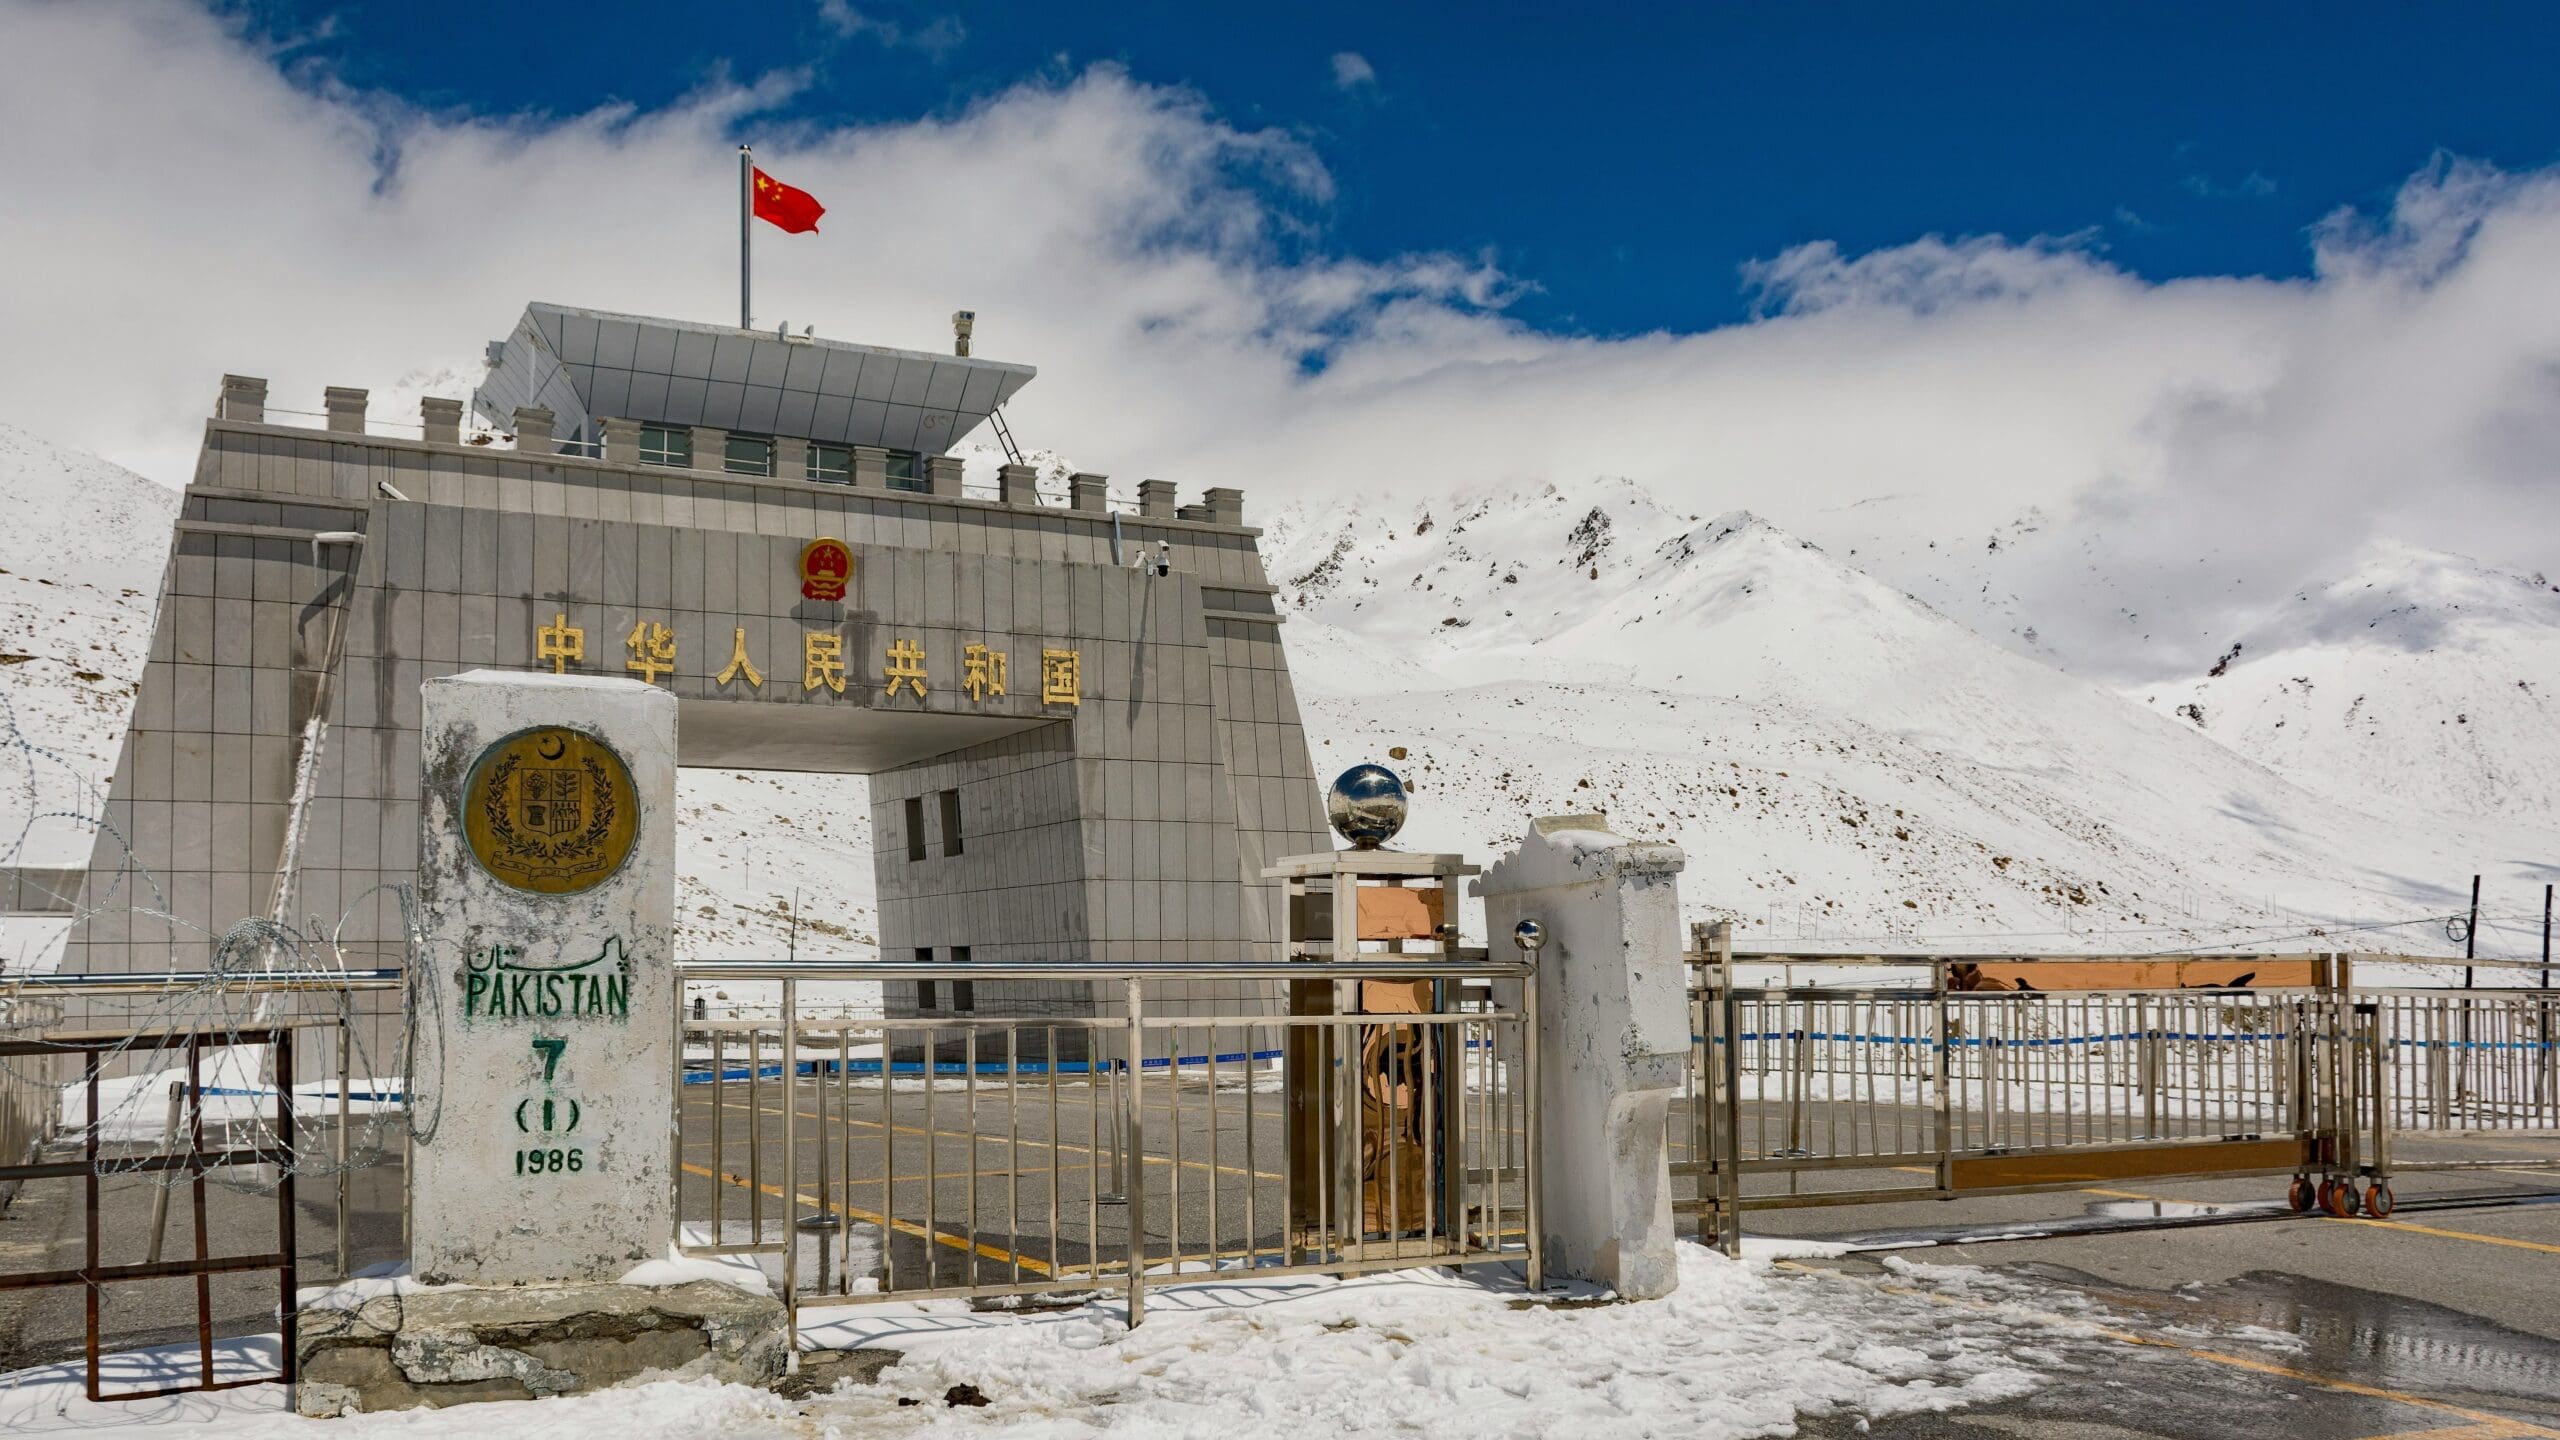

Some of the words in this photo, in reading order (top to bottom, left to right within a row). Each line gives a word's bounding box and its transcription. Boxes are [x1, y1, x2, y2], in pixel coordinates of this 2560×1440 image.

[537, 613, 1080, 706] 中华人民共和国
[466, 973, 629, 1017] PAKISTAN
[532, 1040, 567, 1081] 7
[516, 1149, 583, 1175] 1986
